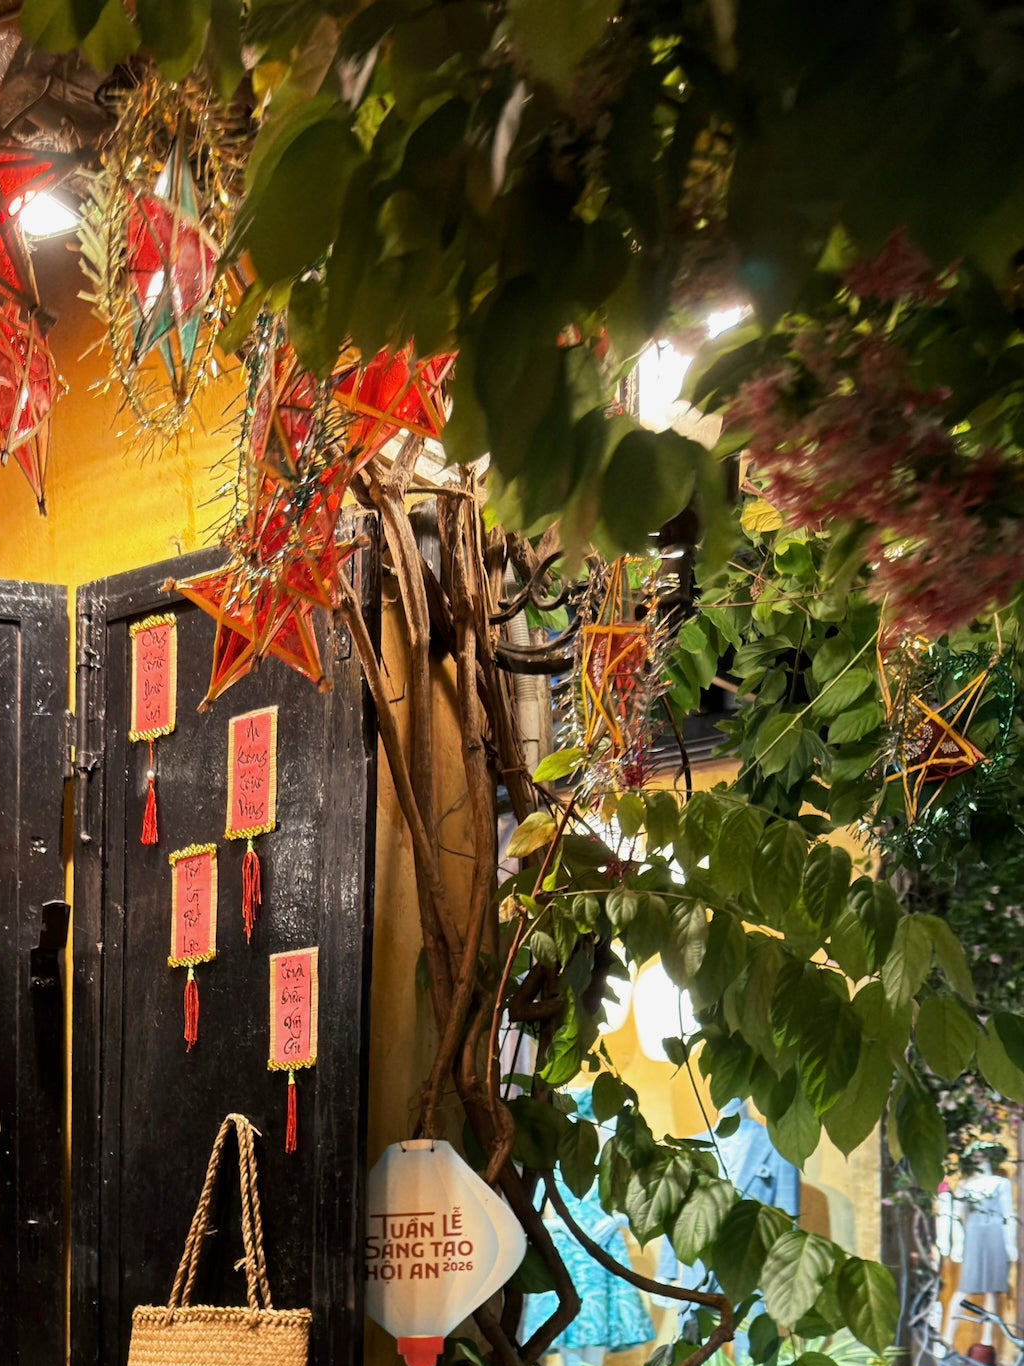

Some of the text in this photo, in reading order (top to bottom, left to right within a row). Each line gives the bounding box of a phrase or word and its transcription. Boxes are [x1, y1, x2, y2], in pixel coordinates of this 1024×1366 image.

[442, 1206, 463, 1237] LỄ
[430, 1240, 473, 1261] TẠO
[366, 1260, 474, 1285] HỘI AN 2026
